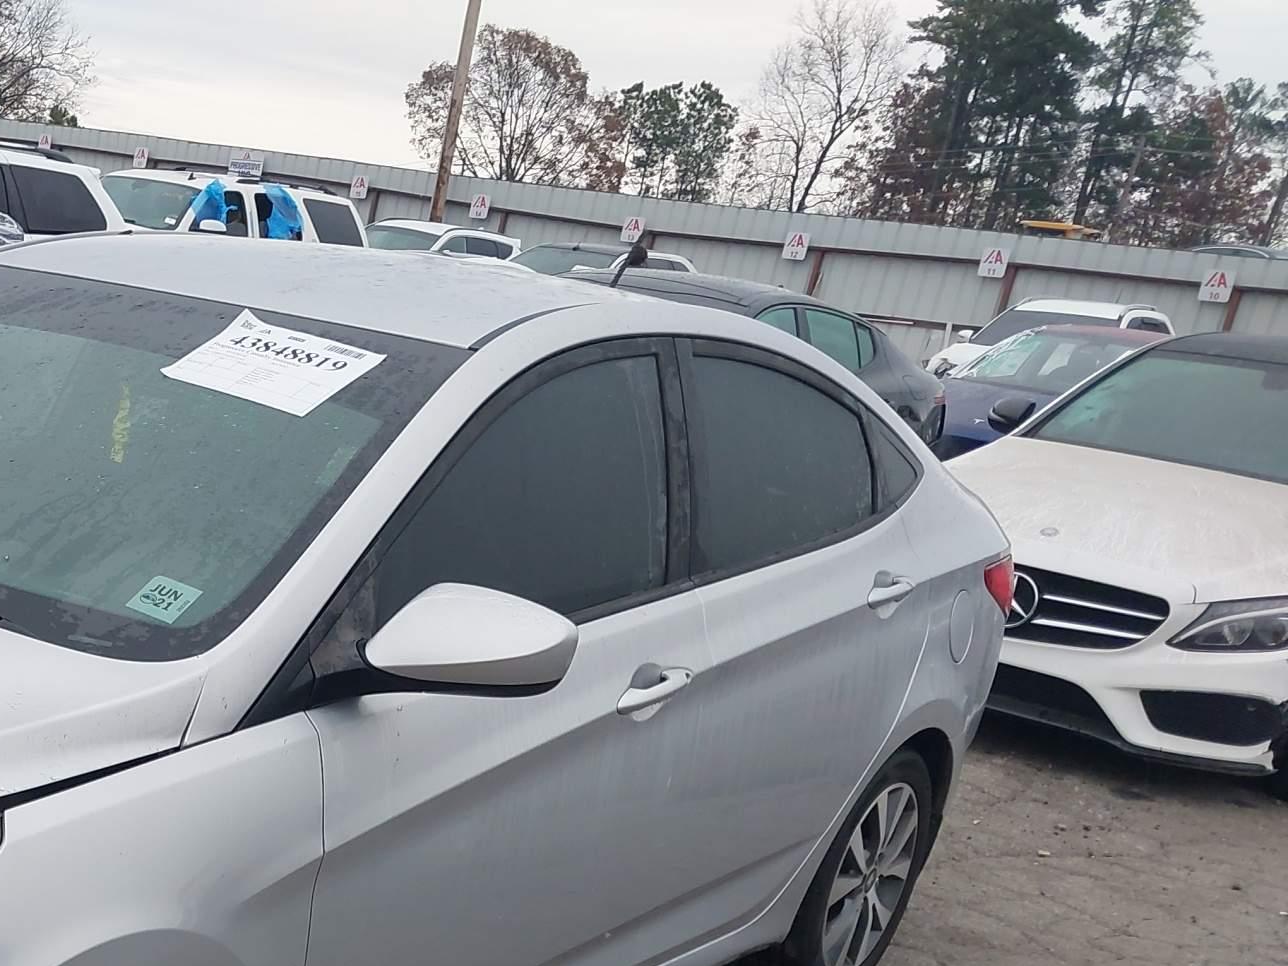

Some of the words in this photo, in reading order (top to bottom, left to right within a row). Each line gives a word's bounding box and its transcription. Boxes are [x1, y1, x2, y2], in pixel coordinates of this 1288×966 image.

[230, 335, 349, 372] 43848819
[149, 584, 183, 601] JUN
[152, 597, 173, 611] 21
